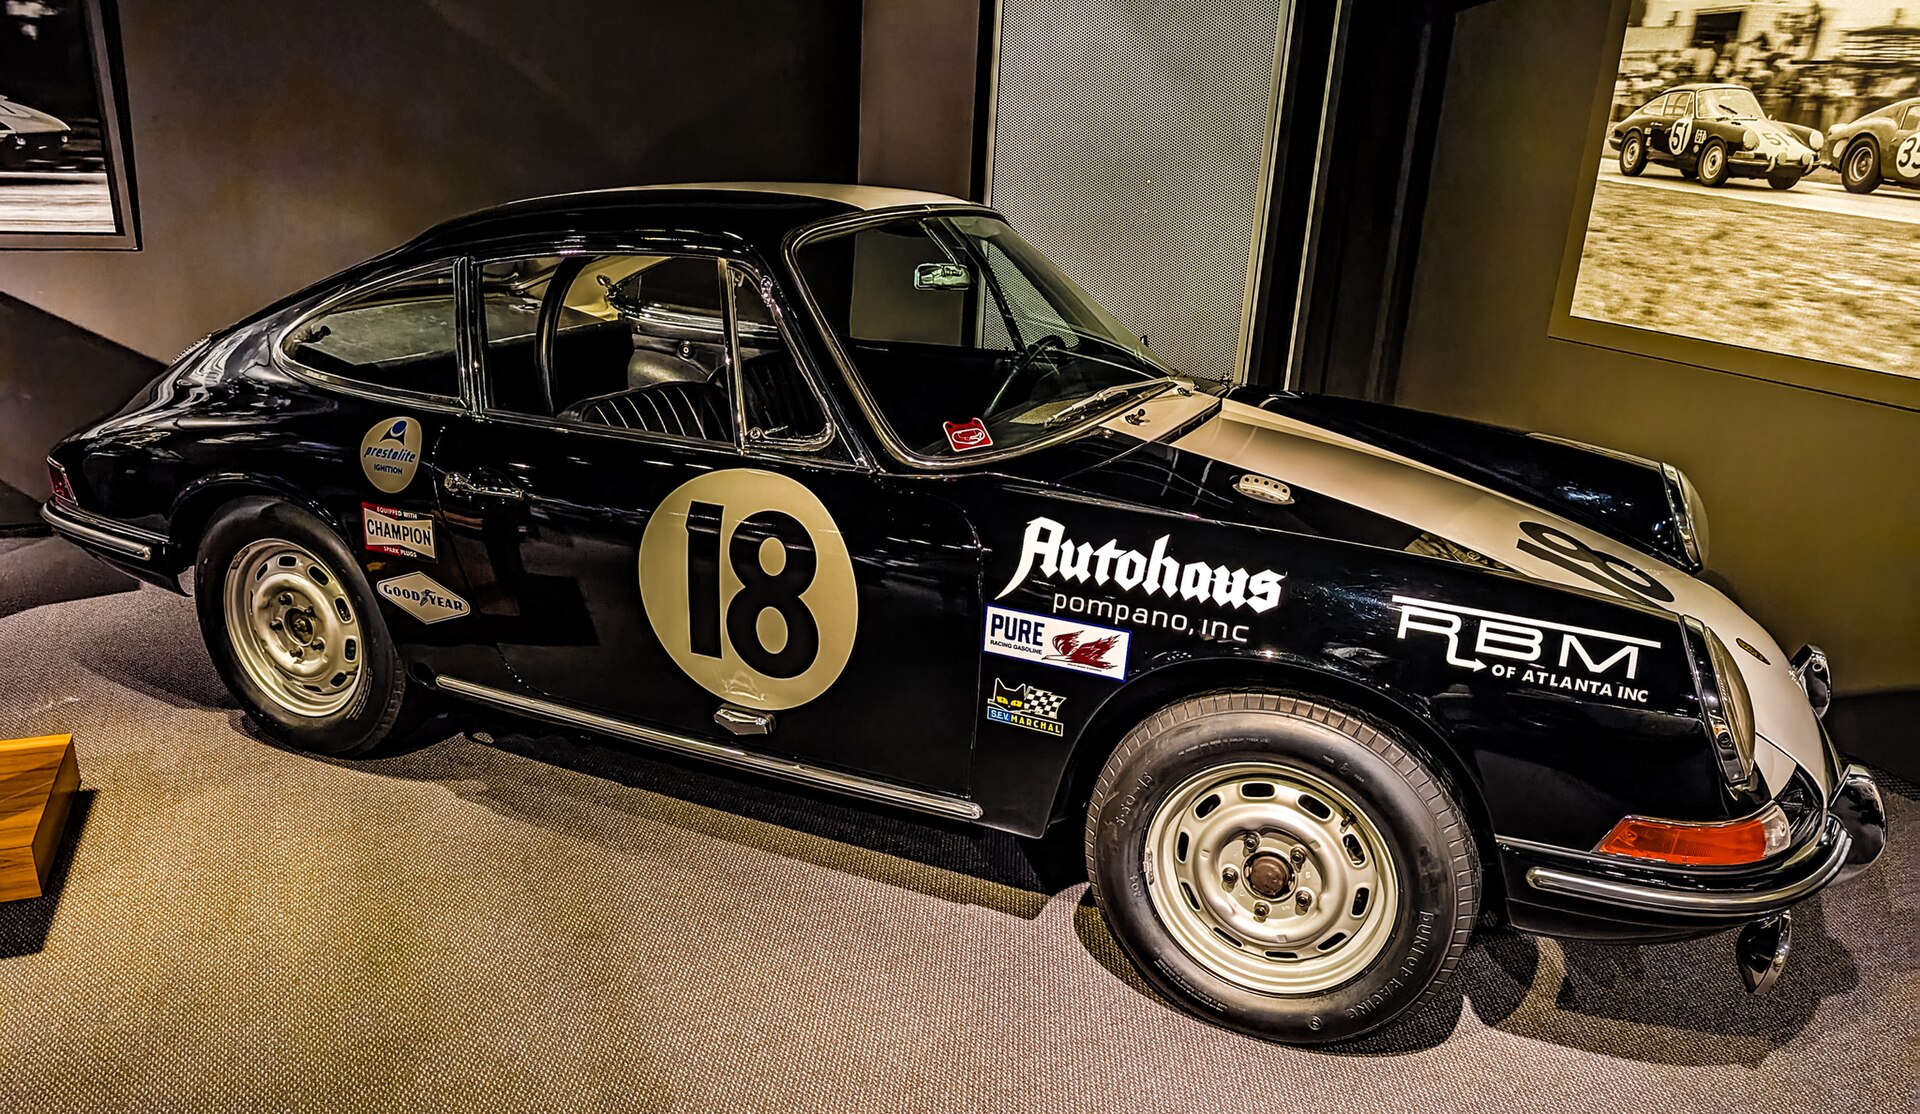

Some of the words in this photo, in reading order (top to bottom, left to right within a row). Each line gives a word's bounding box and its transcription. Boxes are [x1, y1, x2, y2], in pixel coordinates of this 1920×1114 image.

[1671, 122, 1689, 151] 51
[1761, 133, 1790, 146] 51
[363, 446, 416, 464] prestolite
[373, 463, 403, 476] IGNITION
[376, 506, 402, 517] EQUIPPED
[403, 511, 418, 520] WITH
[366, 518, 432, 547] CHAMPION
[383, 546, 400, 555] SPARK
[400, 549, 418, 558] PLUGS
[995, 516, 1288, 614] Autohaus
[685, 501, 820, 679] 18
[990, 613, 1045, 647] PURE
[1396, 604, 1640, 680] RBM
[990, 639, 1013, 649] RACING
[1013, 643, 1043, 656] GASOLINE
[1491, 663, 1516, 679] OF
[1522, 669, 1613, 697] ATLANTA
[1617, 685, 1649, 703] INC
[1010, 714, 1061, 734] MARCHAL
